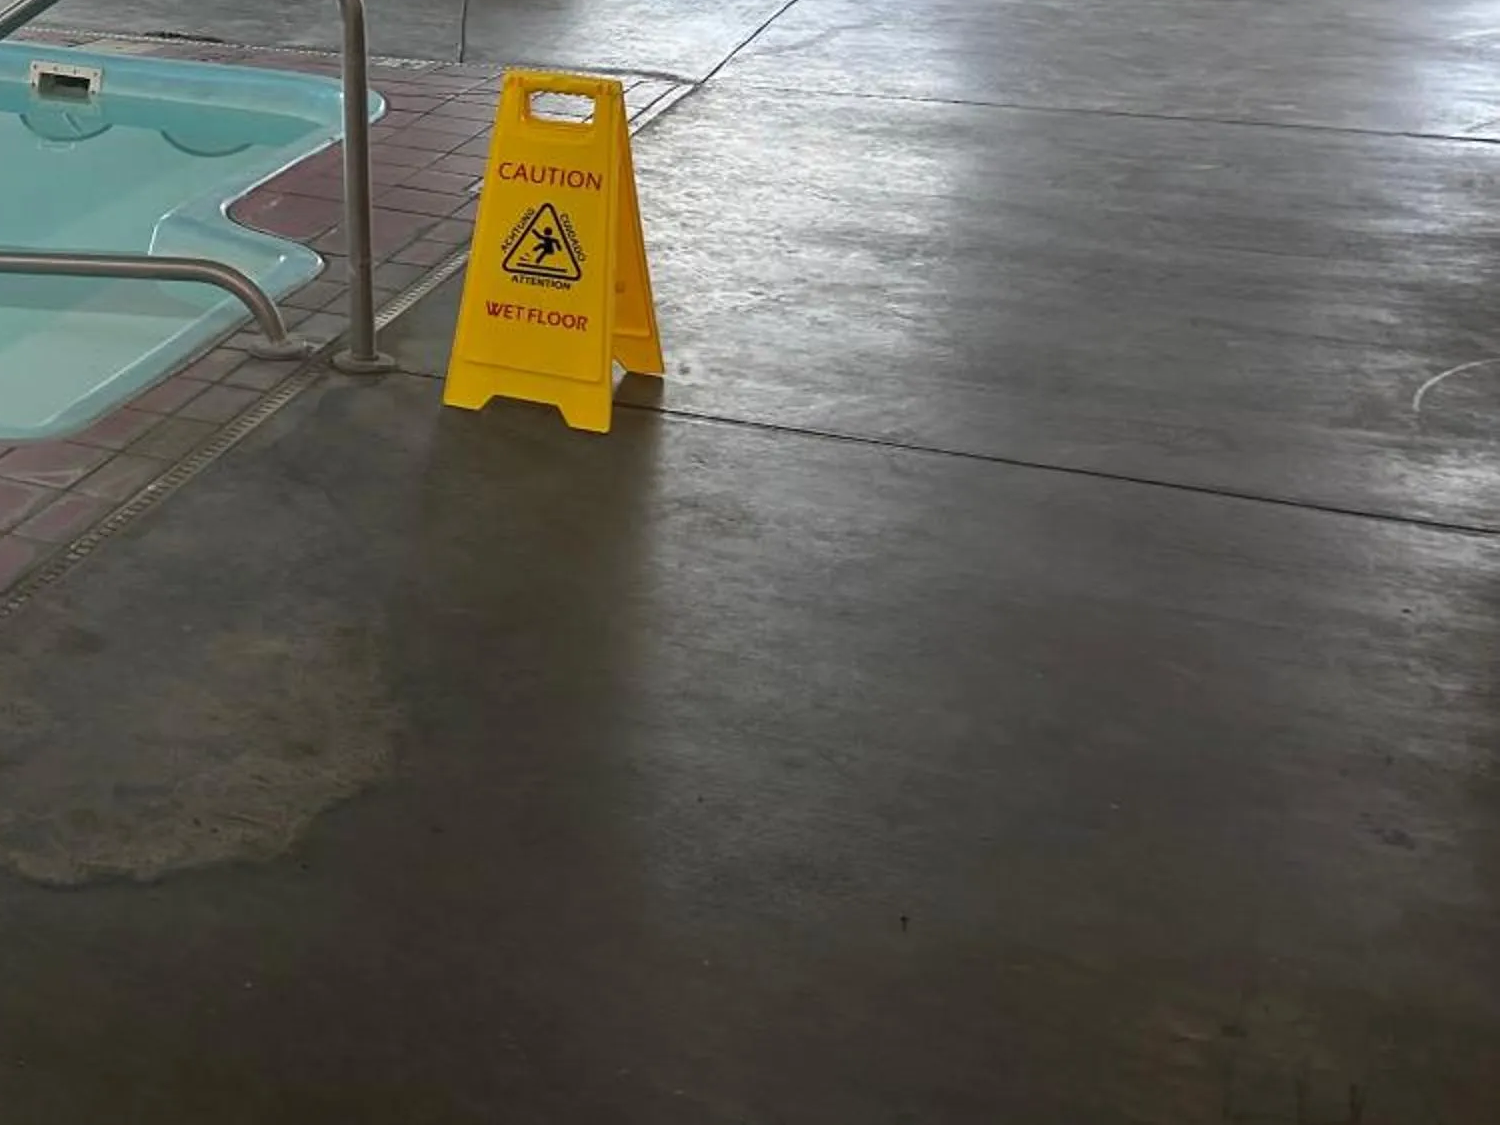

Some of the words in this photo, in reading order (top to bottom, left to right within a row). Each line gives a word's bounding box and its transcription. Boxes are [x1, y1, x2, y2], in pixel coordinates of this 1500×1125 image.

[499, 162, 603, 191] CAUTION
[501, 207, 535, 253] ACHTUNG
[560, 213, 586, 262] CUIDADO
[511, 275, 571, 290] ATTENTION
[486, 300, 525, 321] WET
[527, 308, 589, 331] FLOOR
